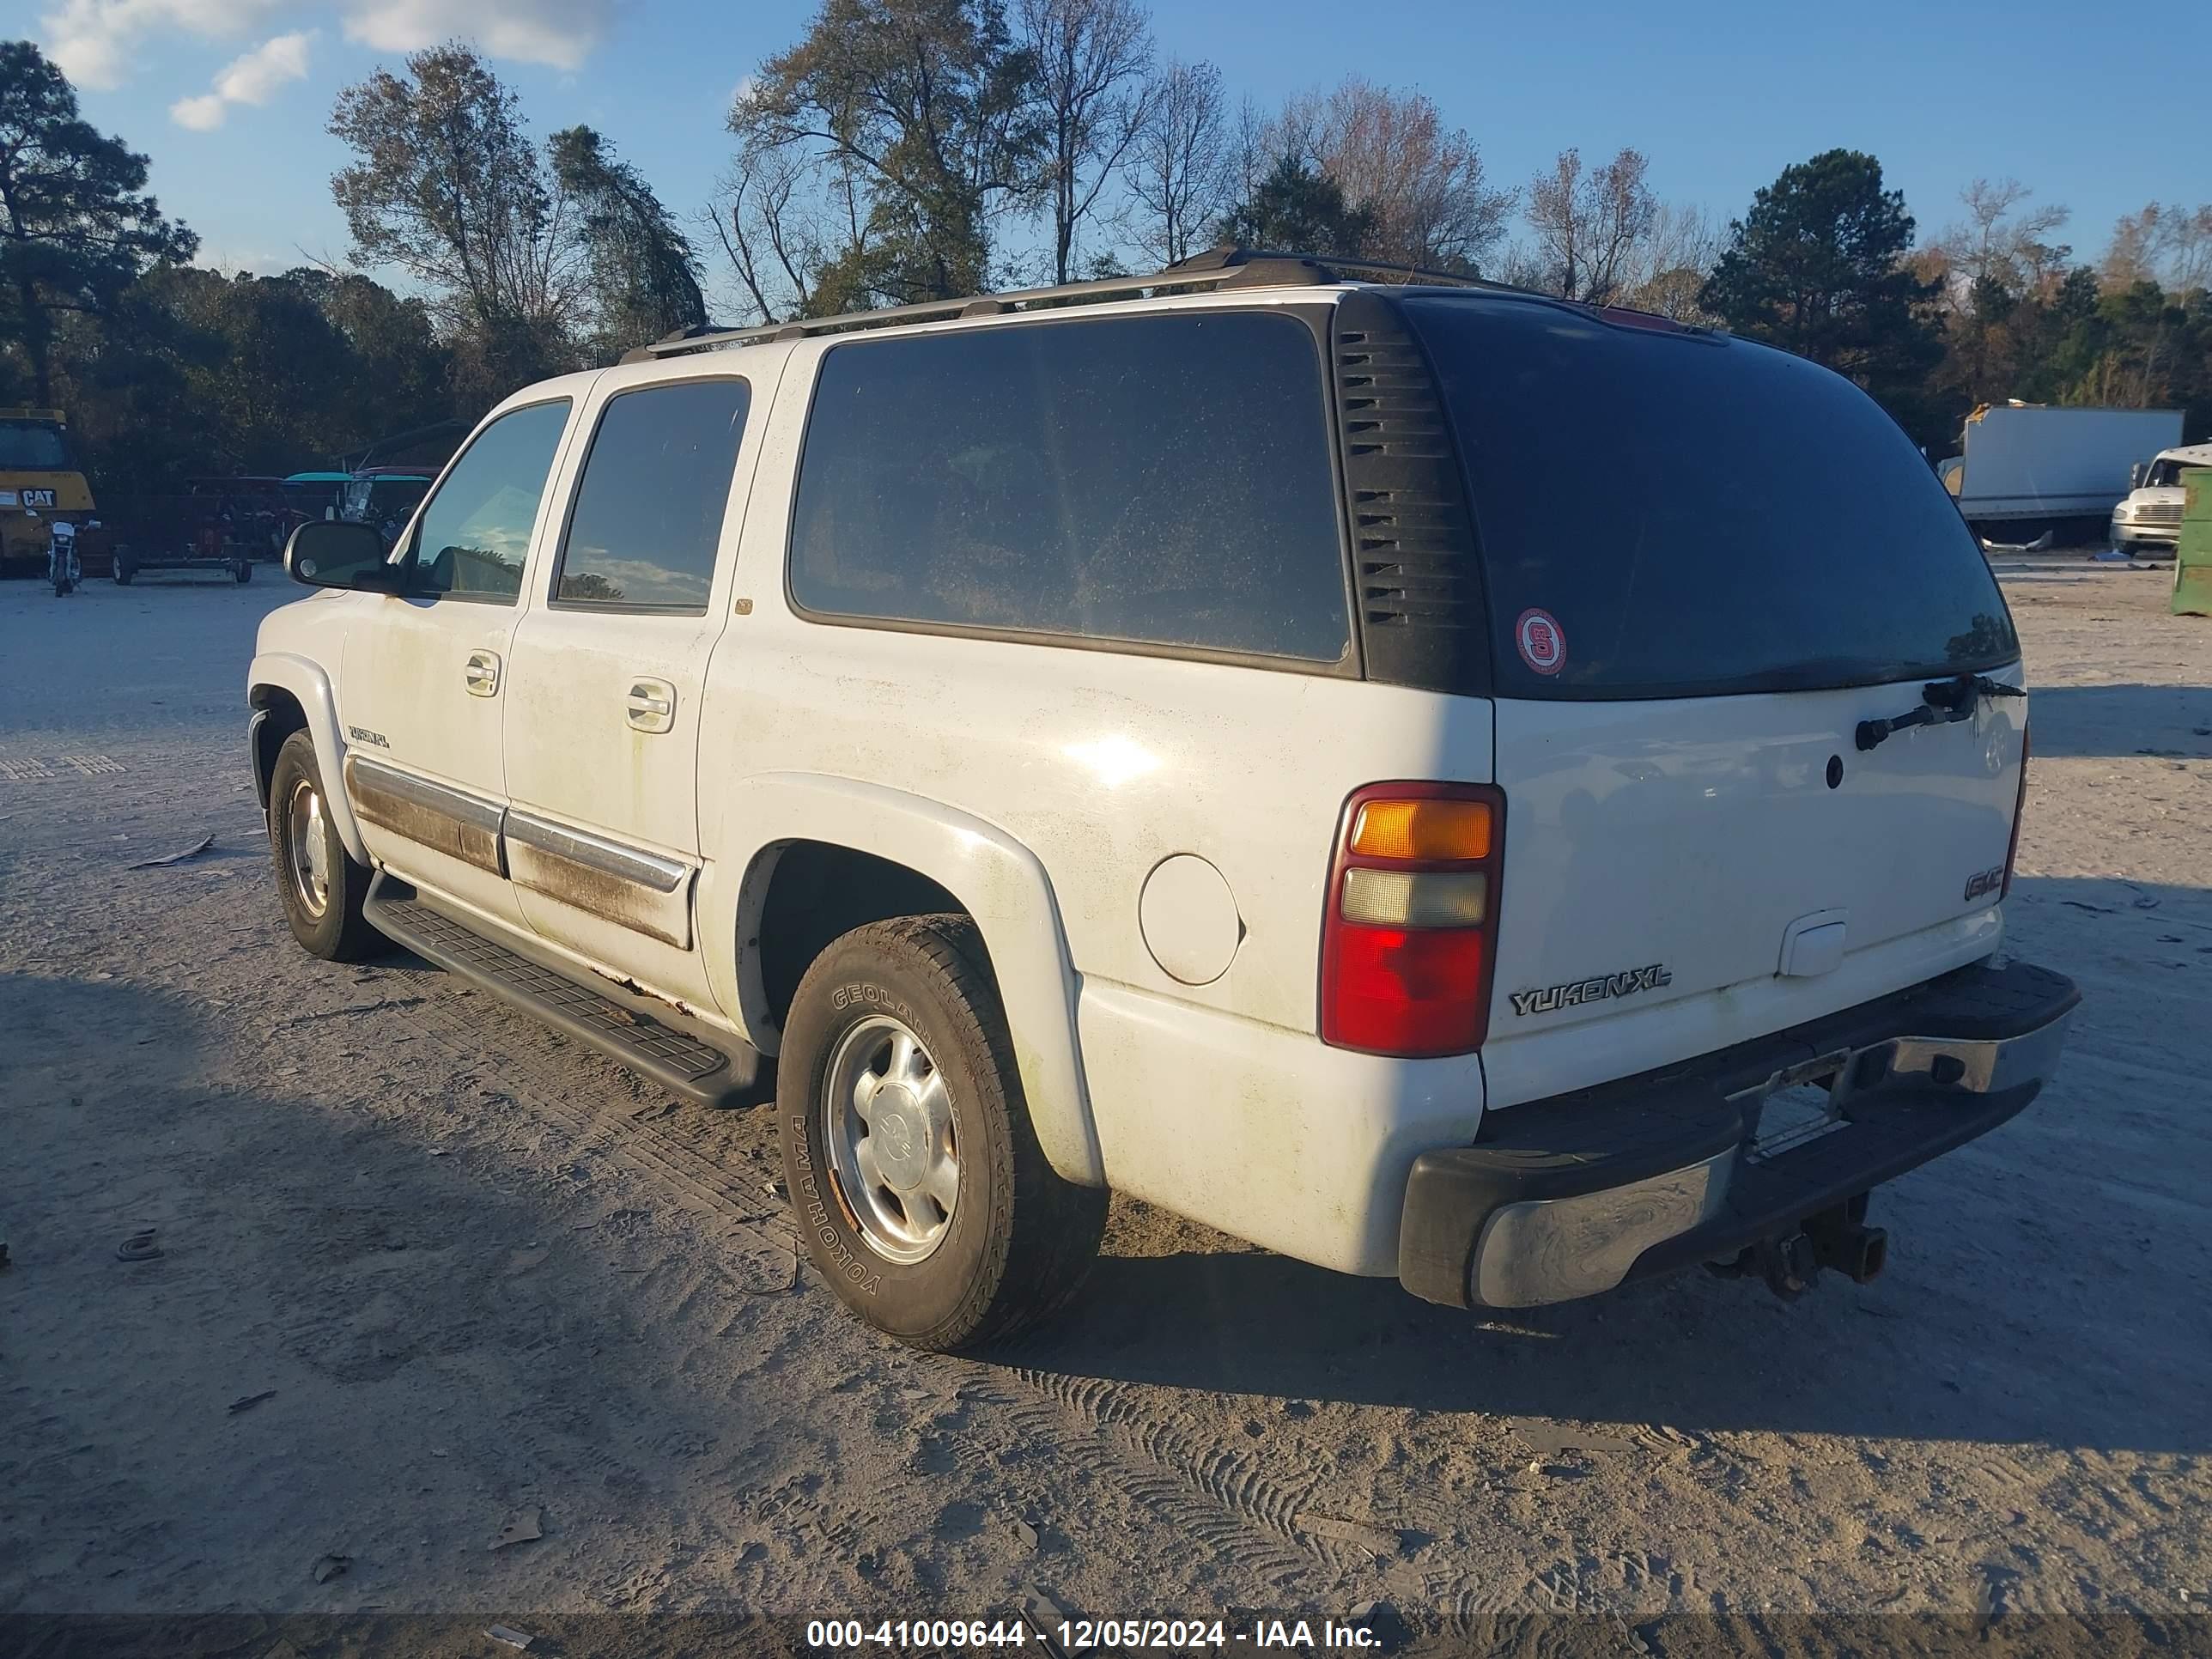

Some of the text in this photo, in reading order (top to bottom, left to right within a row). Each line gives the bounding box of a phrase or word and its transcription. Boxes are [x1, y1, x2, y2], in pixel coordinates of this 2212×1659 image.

[22, 489, 53, 507] CAT
[1964, 864, 2004, 902] GMC
[1509, 963, 1673, 1016] YUKON XL
[831, 983, 964, 1140] GEOLANDAR
[791, 1115, 884, 1297] YOKOHAMA
